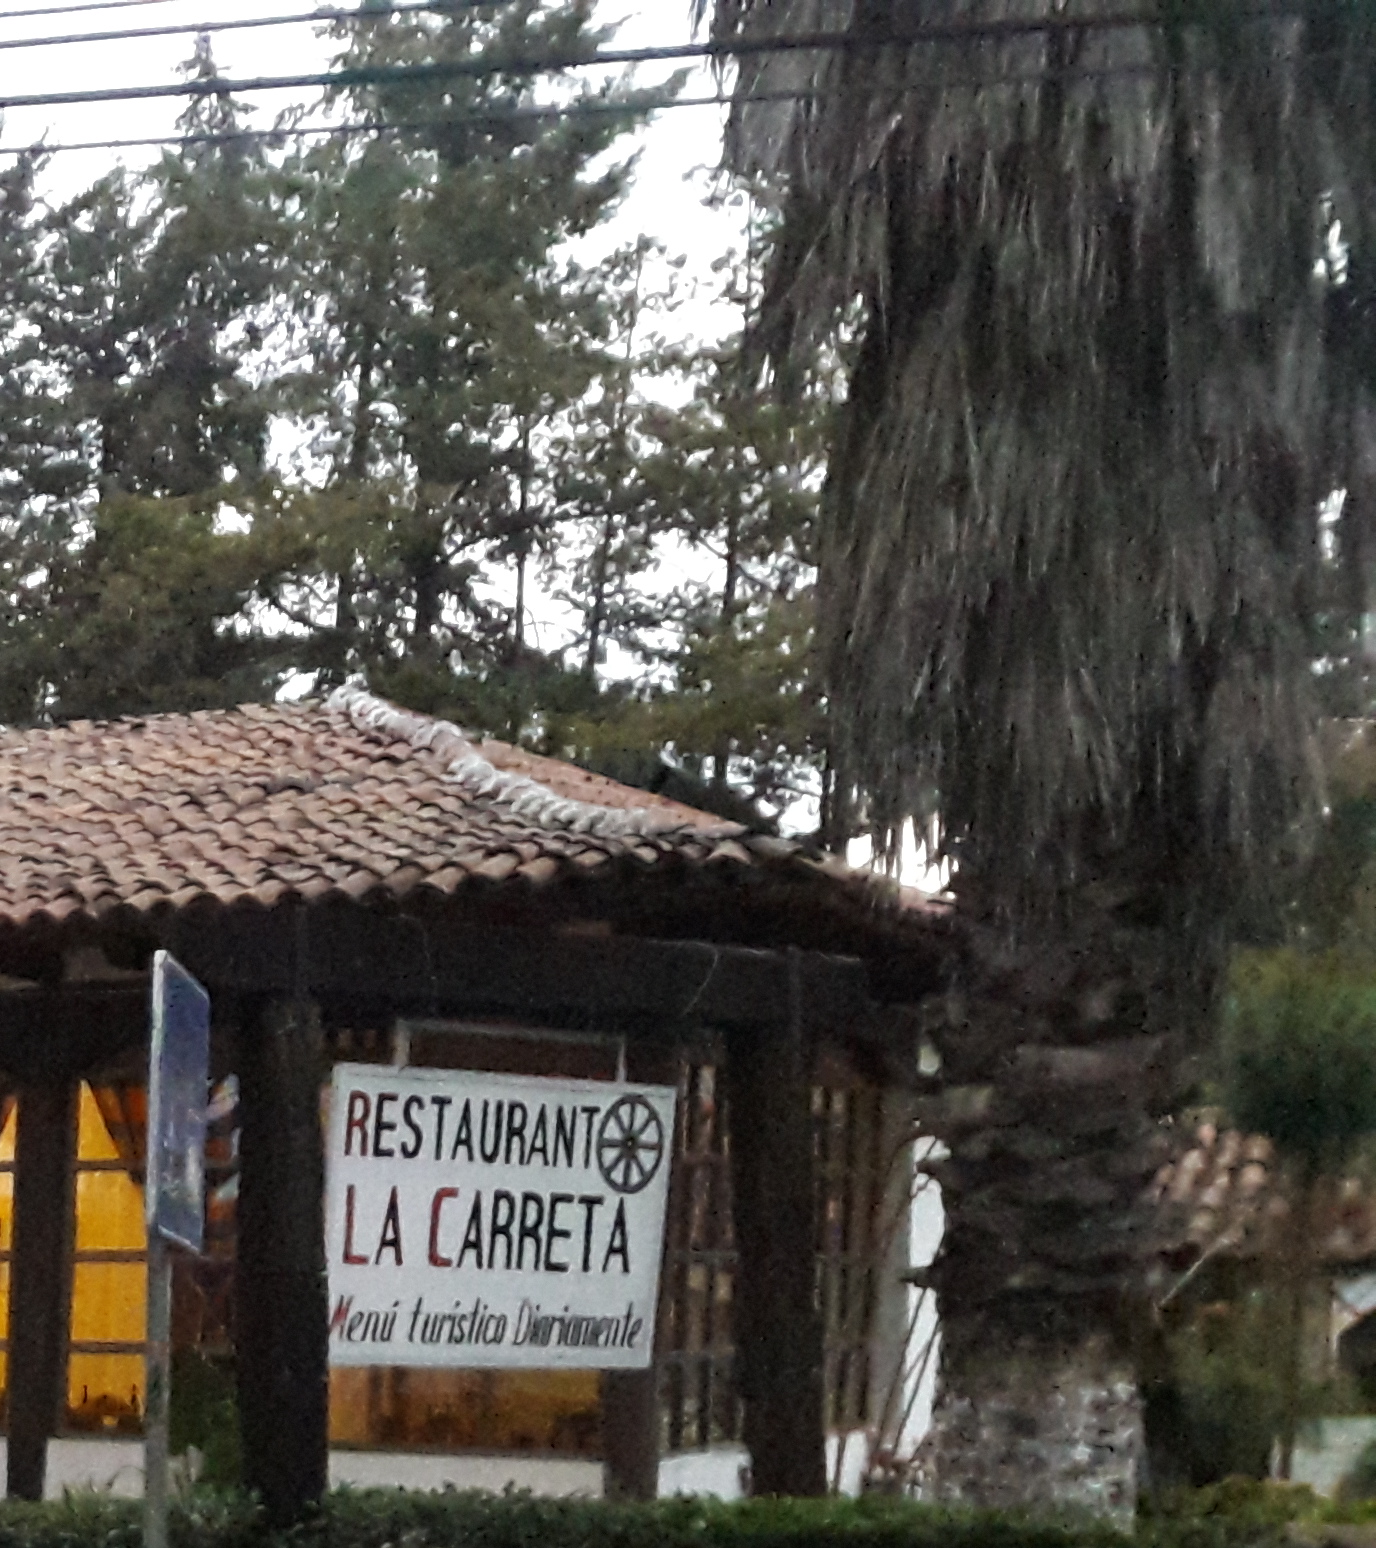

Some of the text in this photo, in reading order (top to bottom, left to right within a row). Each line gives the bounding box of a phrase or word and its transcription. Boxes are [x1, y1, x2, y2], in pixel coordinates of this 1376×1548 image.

[344, 1090, 601, 1169] RESTAURANT
[343, 1184, 630, 1274] LA CARRETA
[329, 1294, 399, 1343] Menú
[513, 1299, 643, 1348] Diariamente
